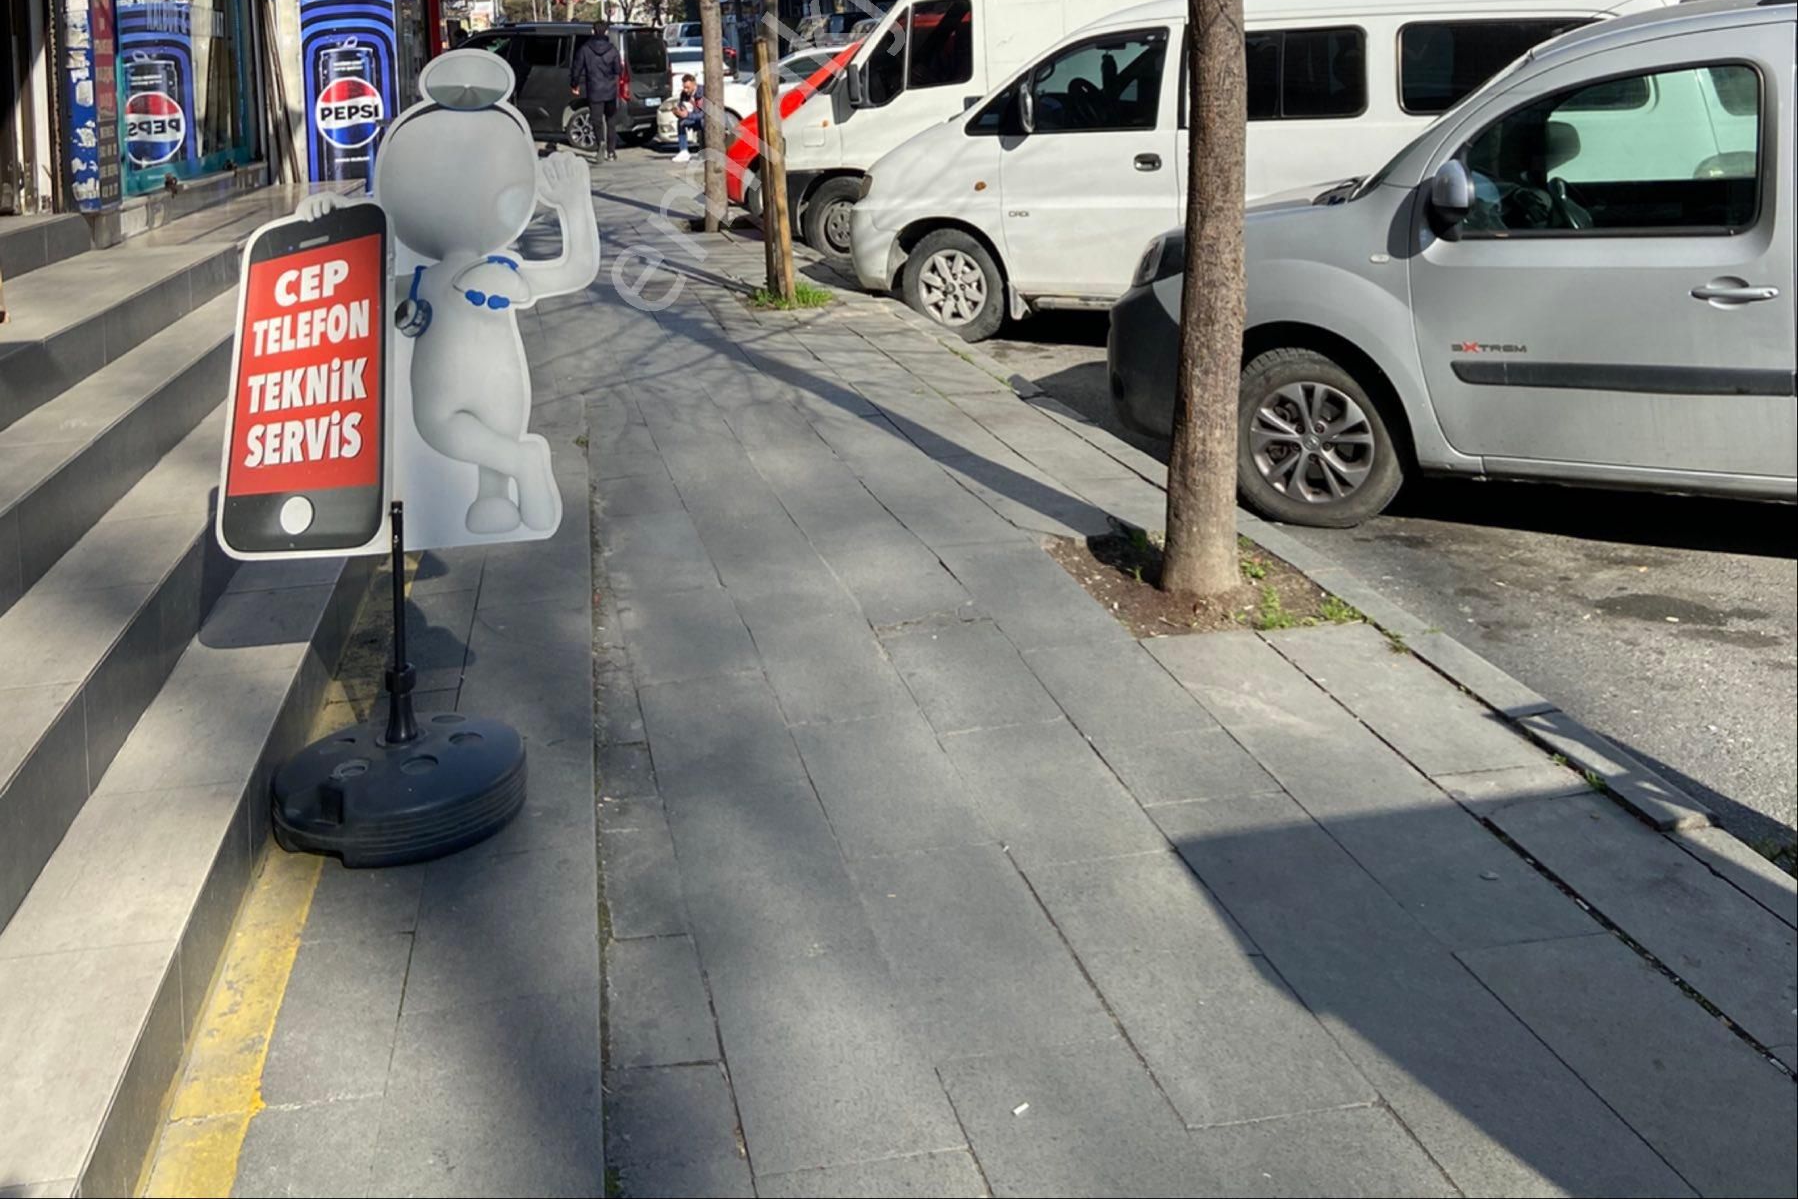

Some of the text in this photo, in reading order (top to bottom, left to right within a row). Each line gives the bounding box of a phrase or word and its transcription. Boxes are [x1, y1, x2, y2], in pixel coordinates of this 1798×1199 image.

[320, 104, 380, 121] PEPSI
[274, 259, 349, 307] CEP
[253, 299, 370, 357] TELEFON
[1451, 342, 1527, 353] EXTREM
